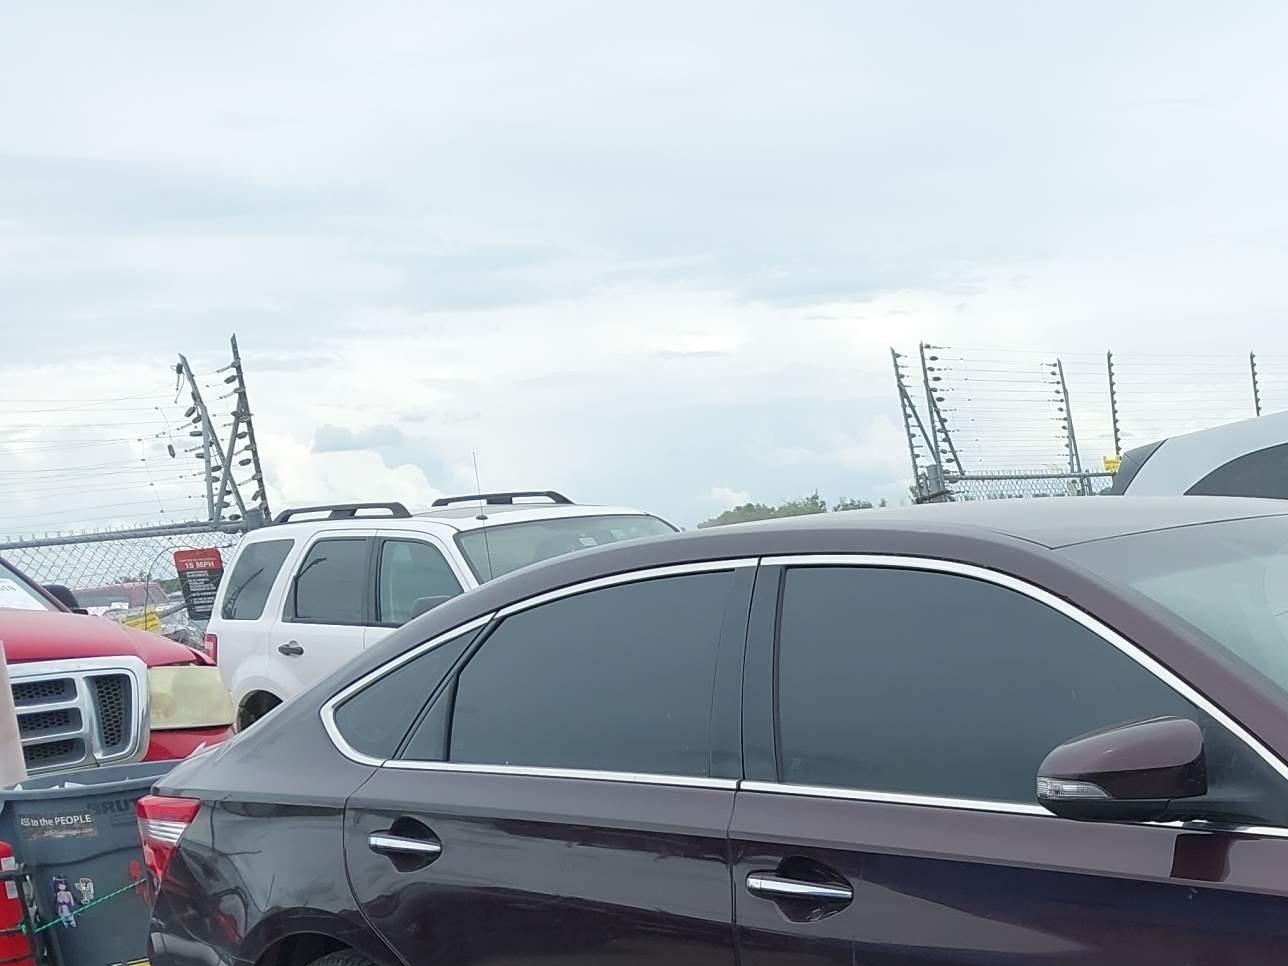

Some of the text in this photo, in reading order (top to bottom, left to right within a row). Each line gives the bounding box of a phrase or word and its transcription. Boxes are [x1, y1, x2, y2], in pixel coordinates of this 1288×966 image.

[196, 560, 215, 569] MPH
[39, 817, 54, 827] the
[54, 814, 92, 825] PEOPLE
